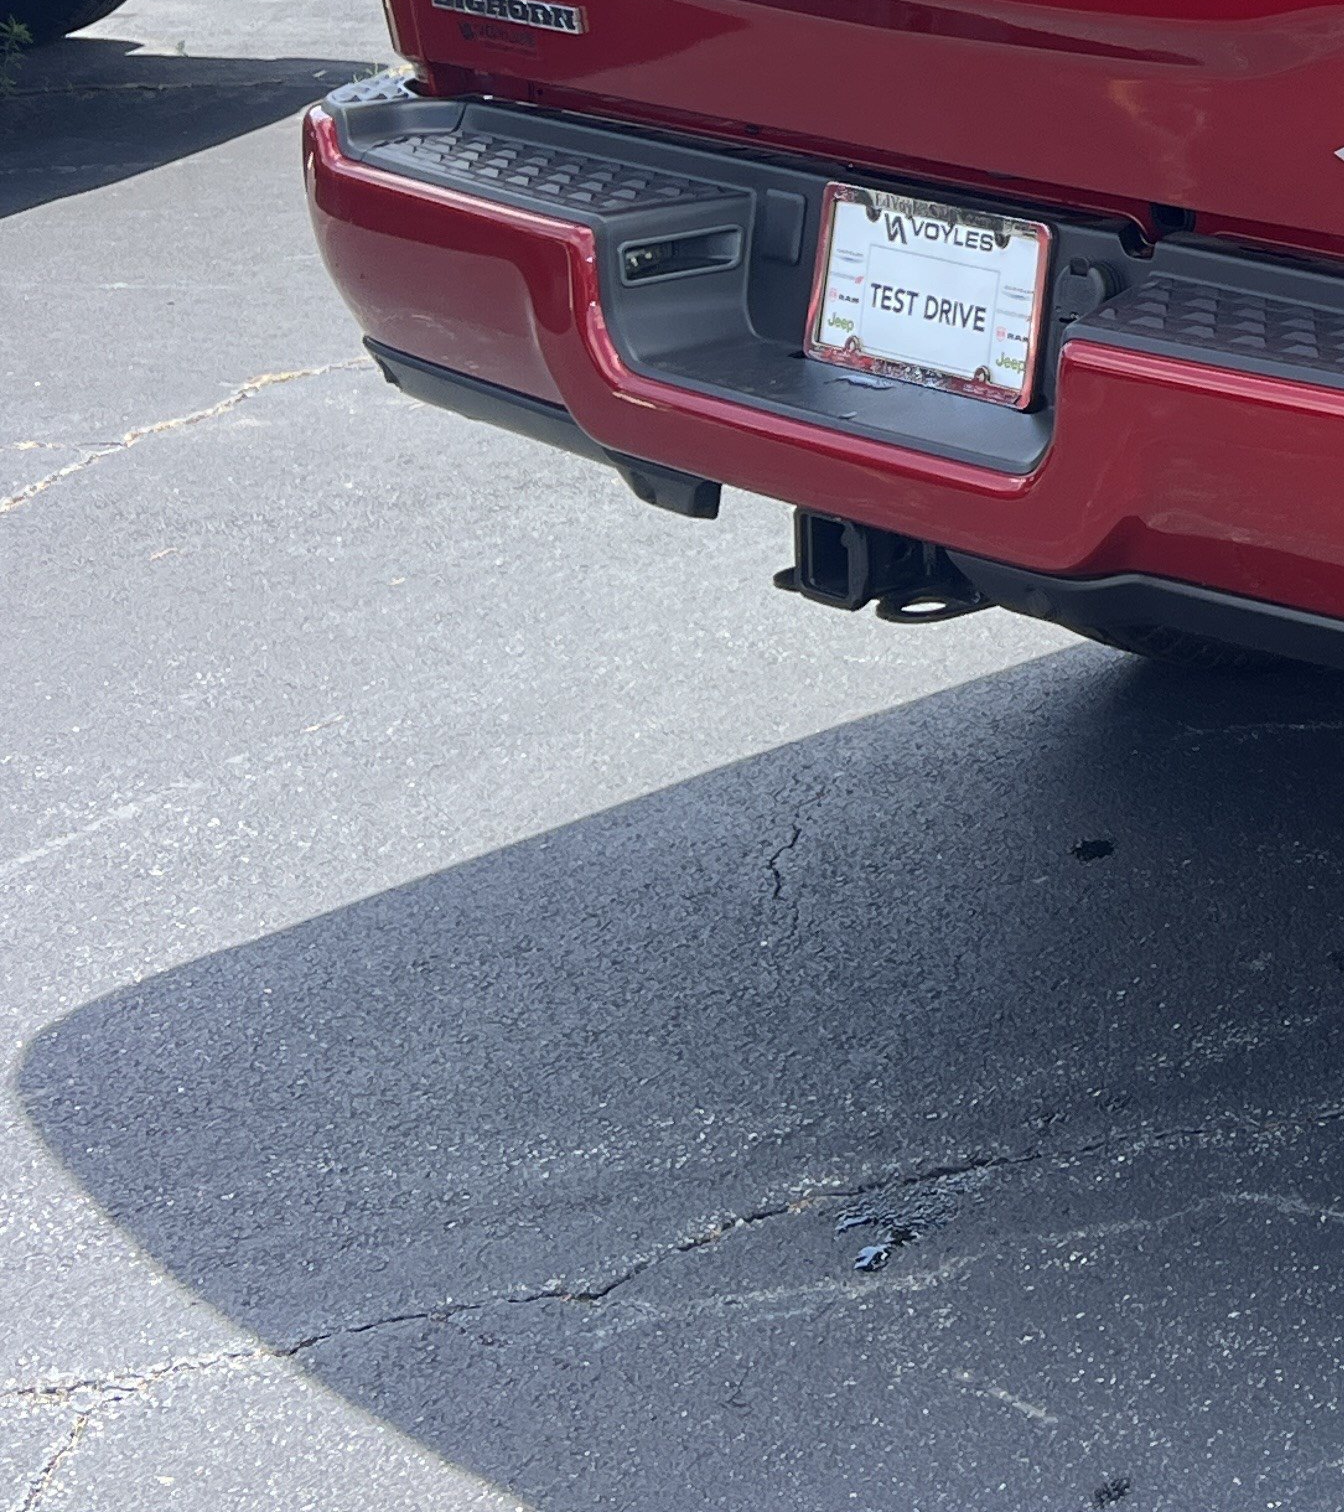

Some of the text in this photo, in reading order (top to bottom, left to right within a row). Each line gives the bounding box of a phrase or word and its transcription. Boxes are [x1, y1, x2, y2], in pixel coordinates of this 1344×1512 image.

[911, 219, 994, 252] VOYLES
[827, 312, 855, 332] Jeep
[870, 283, 987, 332] TEST DRIVE
